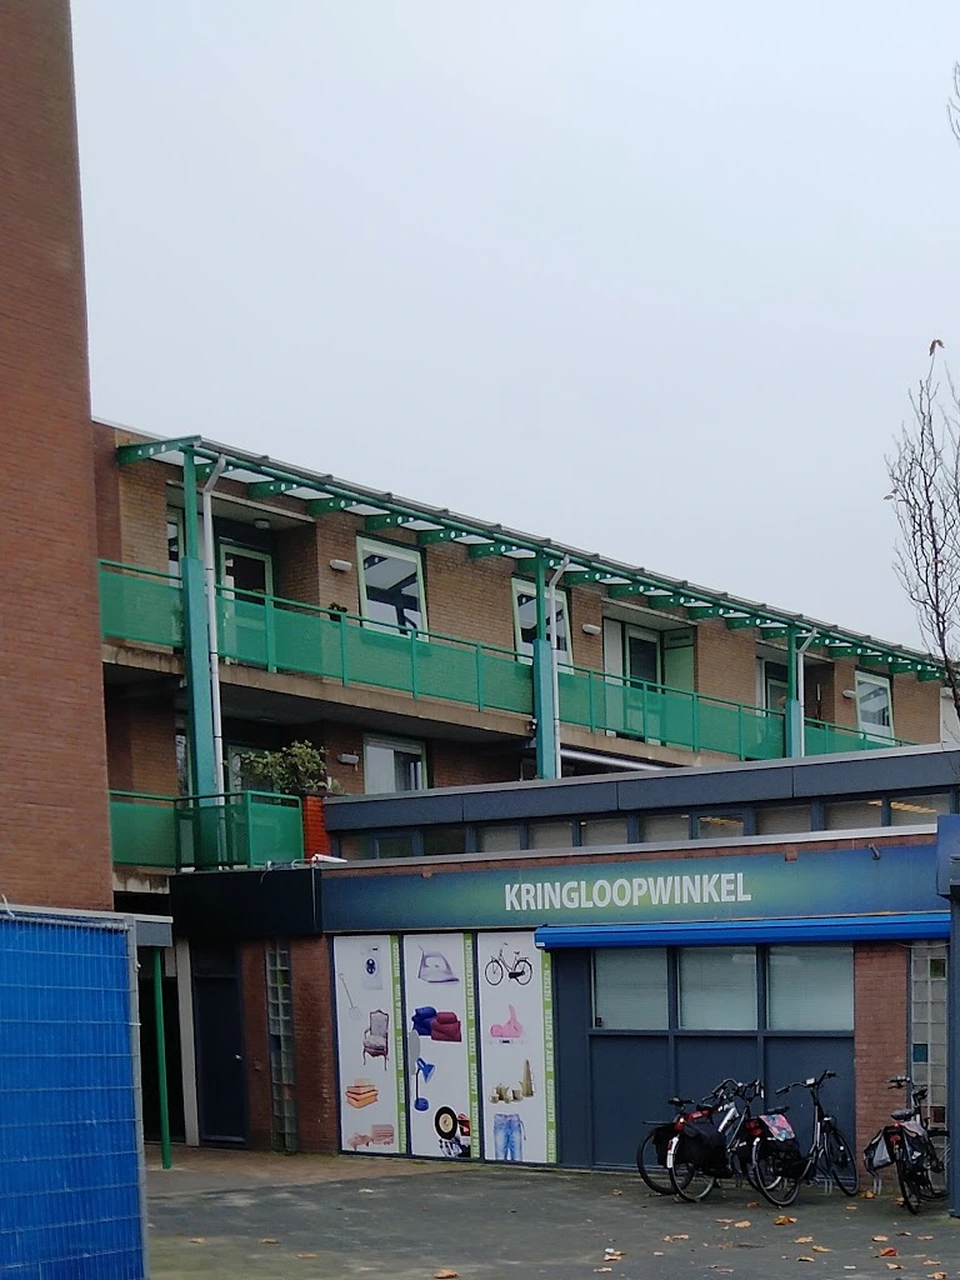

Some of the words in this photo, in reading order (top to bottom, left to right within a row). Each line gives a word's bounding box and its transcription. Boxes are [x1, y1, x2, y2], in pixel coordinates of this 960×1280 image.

[504, 872, 752, 911] KRINGLOOPWINKEL
[544, 1008, 553, 1040] PEUTER
[545, 1050, 554, 1072] BABY
[547, 1129, 556, 1163] KLEDING
